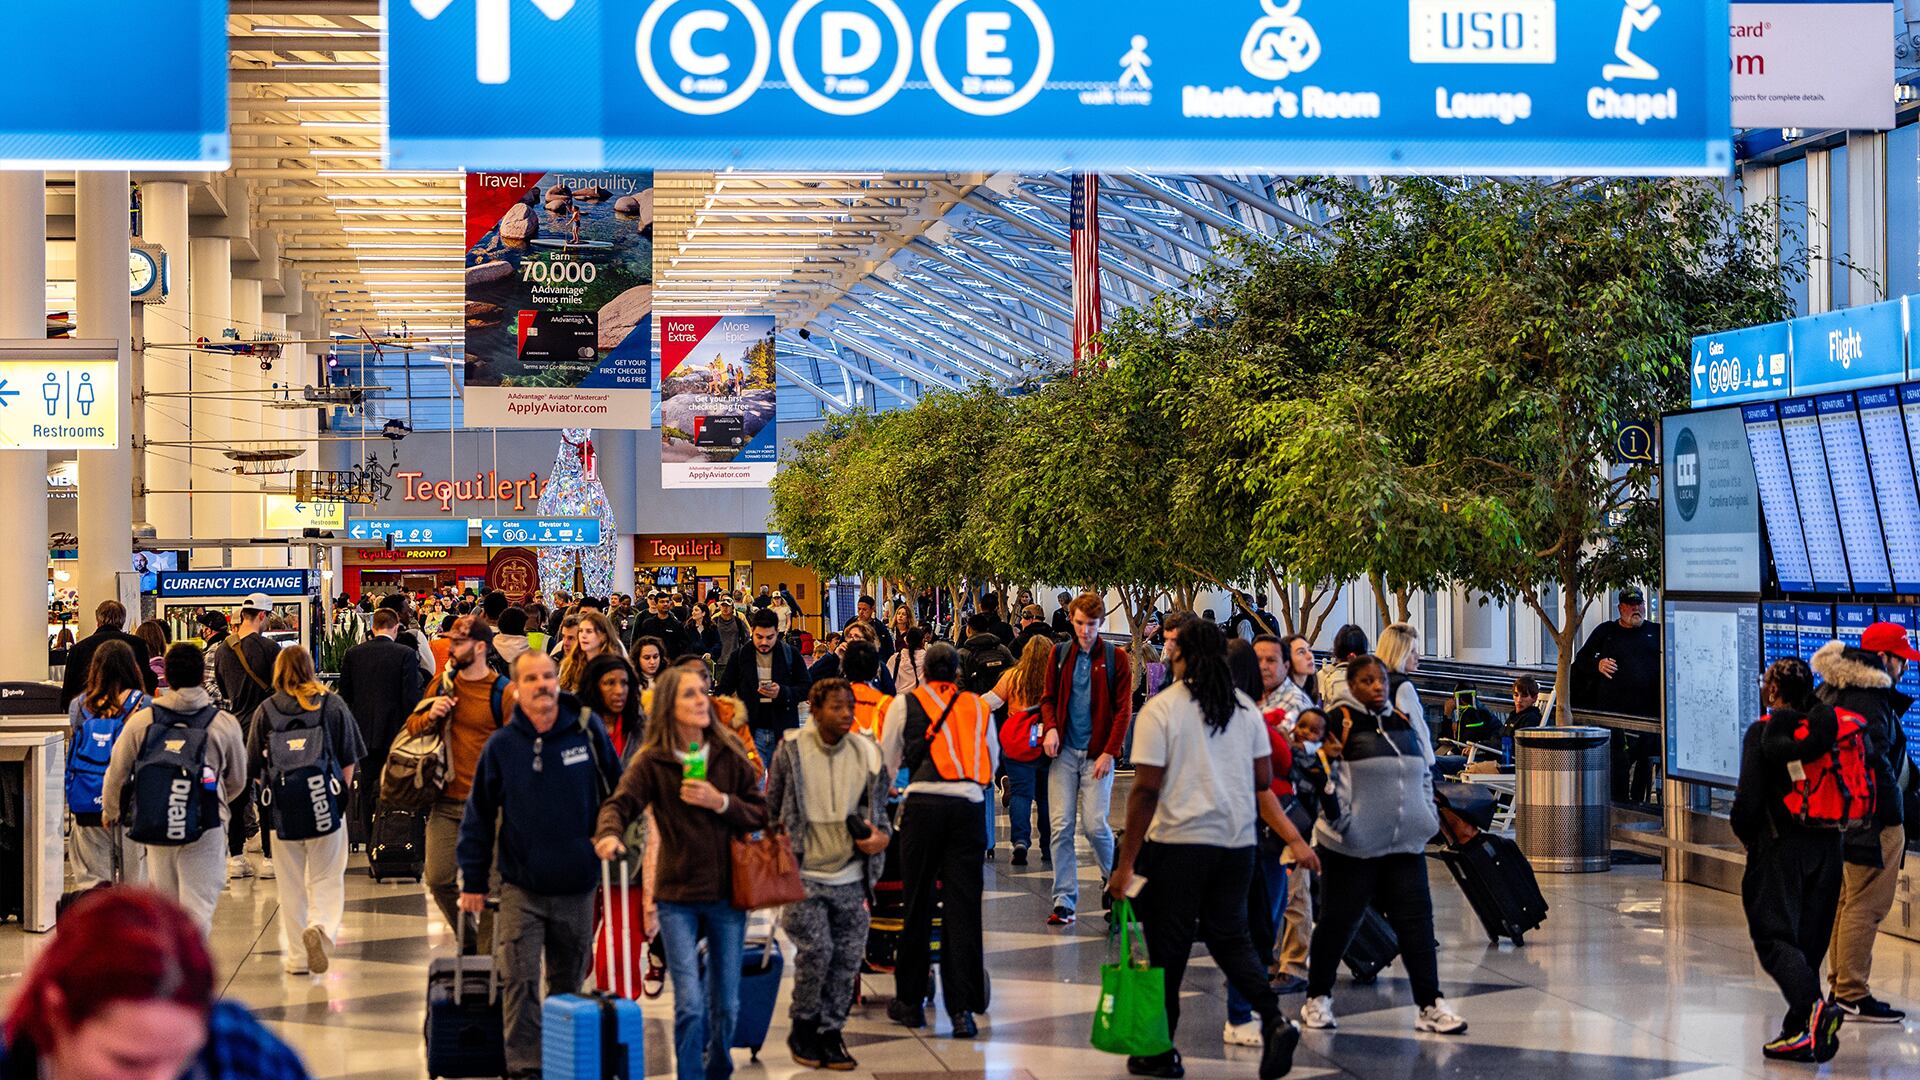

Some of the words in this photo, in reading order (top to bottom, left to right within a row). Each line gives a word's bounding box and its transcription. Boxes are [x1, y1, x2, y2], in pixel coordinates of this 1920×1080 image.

[1441, 11, 1524, 50] USO
[669, 9, 731, 77] C
[821, 11, 883, 76] D
[965, 11, 1014, 76] E
[1182, 85, 1298, 119] Mother's
[1302, 85, 1381, 119] Room
[1757, 93, 1768, 101] for
[1768, 94, 1801, 103] complete
[1435, 86, 1532, 125] Lounge
[1586, 86, 1678, 125] Chapel
[476, 172, 526, 188] Travel.
[553, 174, 637, 194] Tranquility.
[550, 252, 570, 260] Earn
[519, 261, 597, 286] 70,000
[532, 295, 558, 304] bonus
[560, 295, 583, 304] miles
[667, 321, 695, 332] More
[722, 321, 750, 332] More
[668, 332, 698, 342] Extras.
[725, 332, 744, 343] Epic
[1709, 341, 1724, 357] Gates
[1828, 327, 1863, 370] Flight
[617, 367, 647, 375] CHECKED
[727, 394, 743, 402] first
[1821, 399, 1845, 410] DEPARTURES
[1863, 394, 1887, 405] DEPARTURES
[508, 402, 608, 415] ApplyAviator.com
[720, 403, 733, 412] bag
[1747, 409, 1769, 419] DEPARTURES
[1784, 404, 1807, 415] DEPARTURES
[33, 424, 104, 438] Restrooms
[688, 472, 750, 480] ApplyAviator.com
[1680, 489, 1694, 499] LOCAL
[370, 521, 382, 529] Exit
[650, 539, 722, 561] Tequileria
[163, 578, 231, 590] CURRENCY
[232, 576, 302, 589] EXCHANGE
[166, 779, 191, 840] arena
[307, 774, 332, 832] arena
